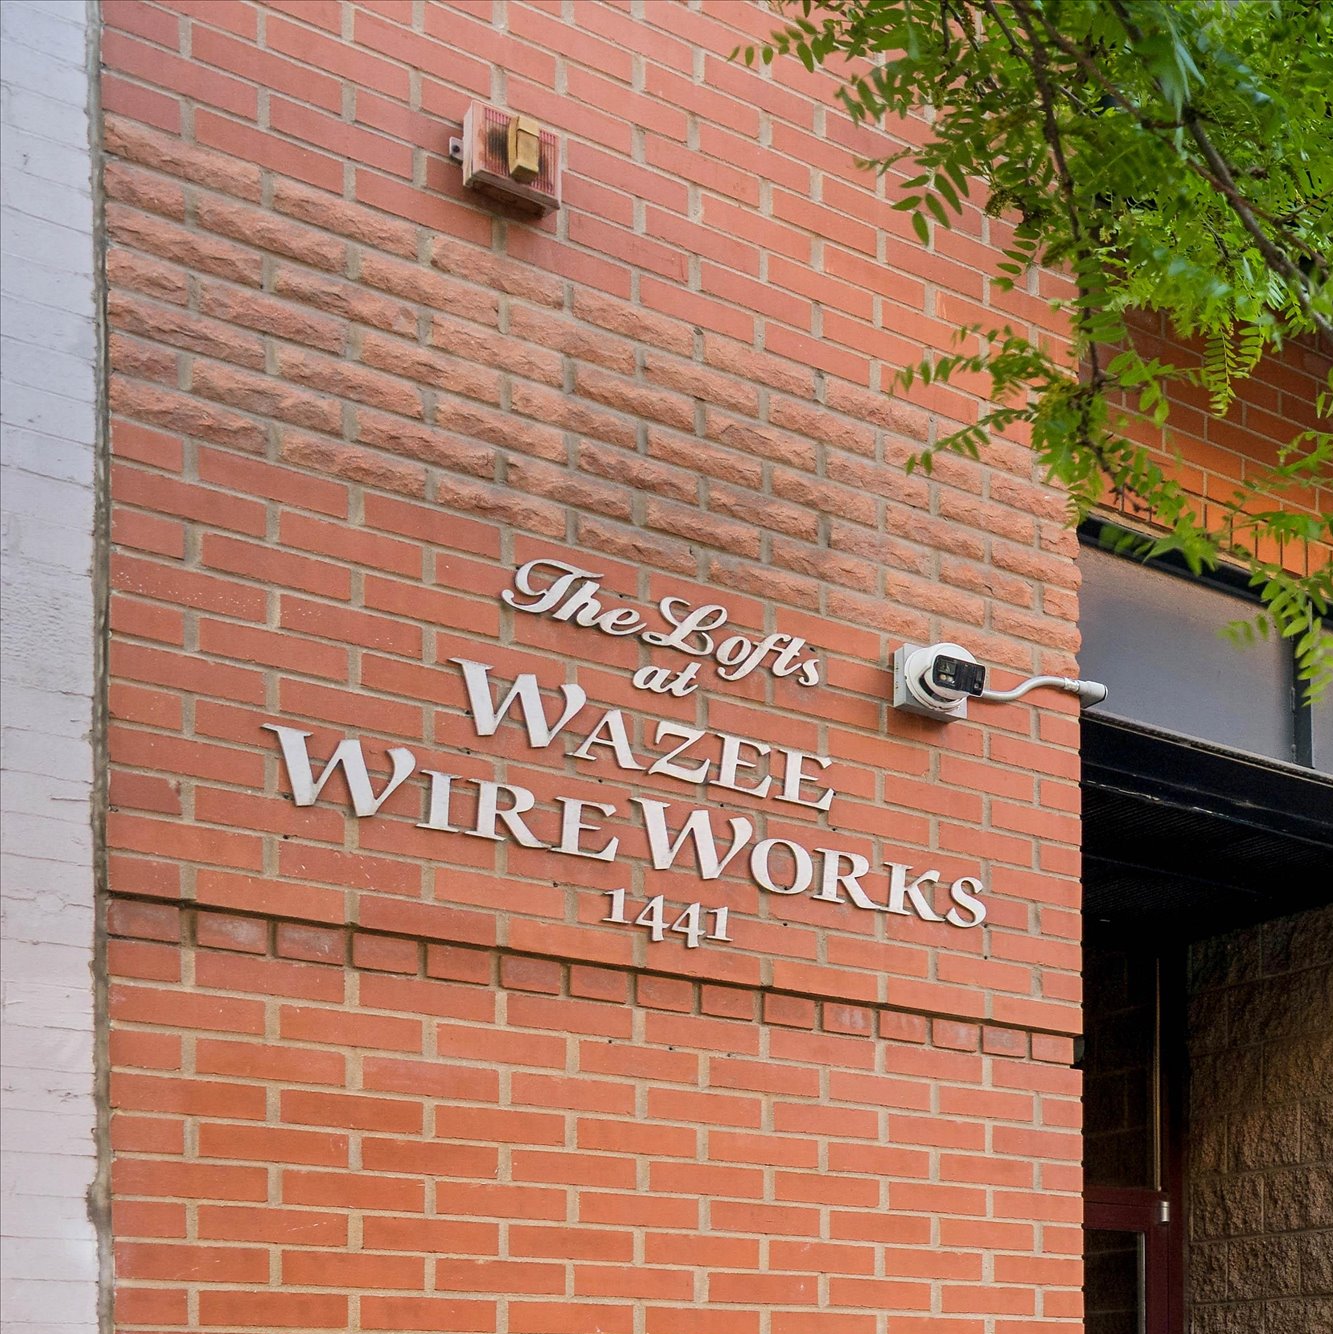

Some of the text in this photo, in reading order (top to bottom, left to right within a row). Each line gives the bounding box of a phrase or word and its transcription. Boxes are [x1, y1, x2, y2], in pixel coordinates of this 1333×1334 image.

[501, 558, 821, 688] The Lofts
[633, 660, 699, 698] at
[449, 656, 834, 813] WAZEE
[602, 887, 734, 949] 1441
